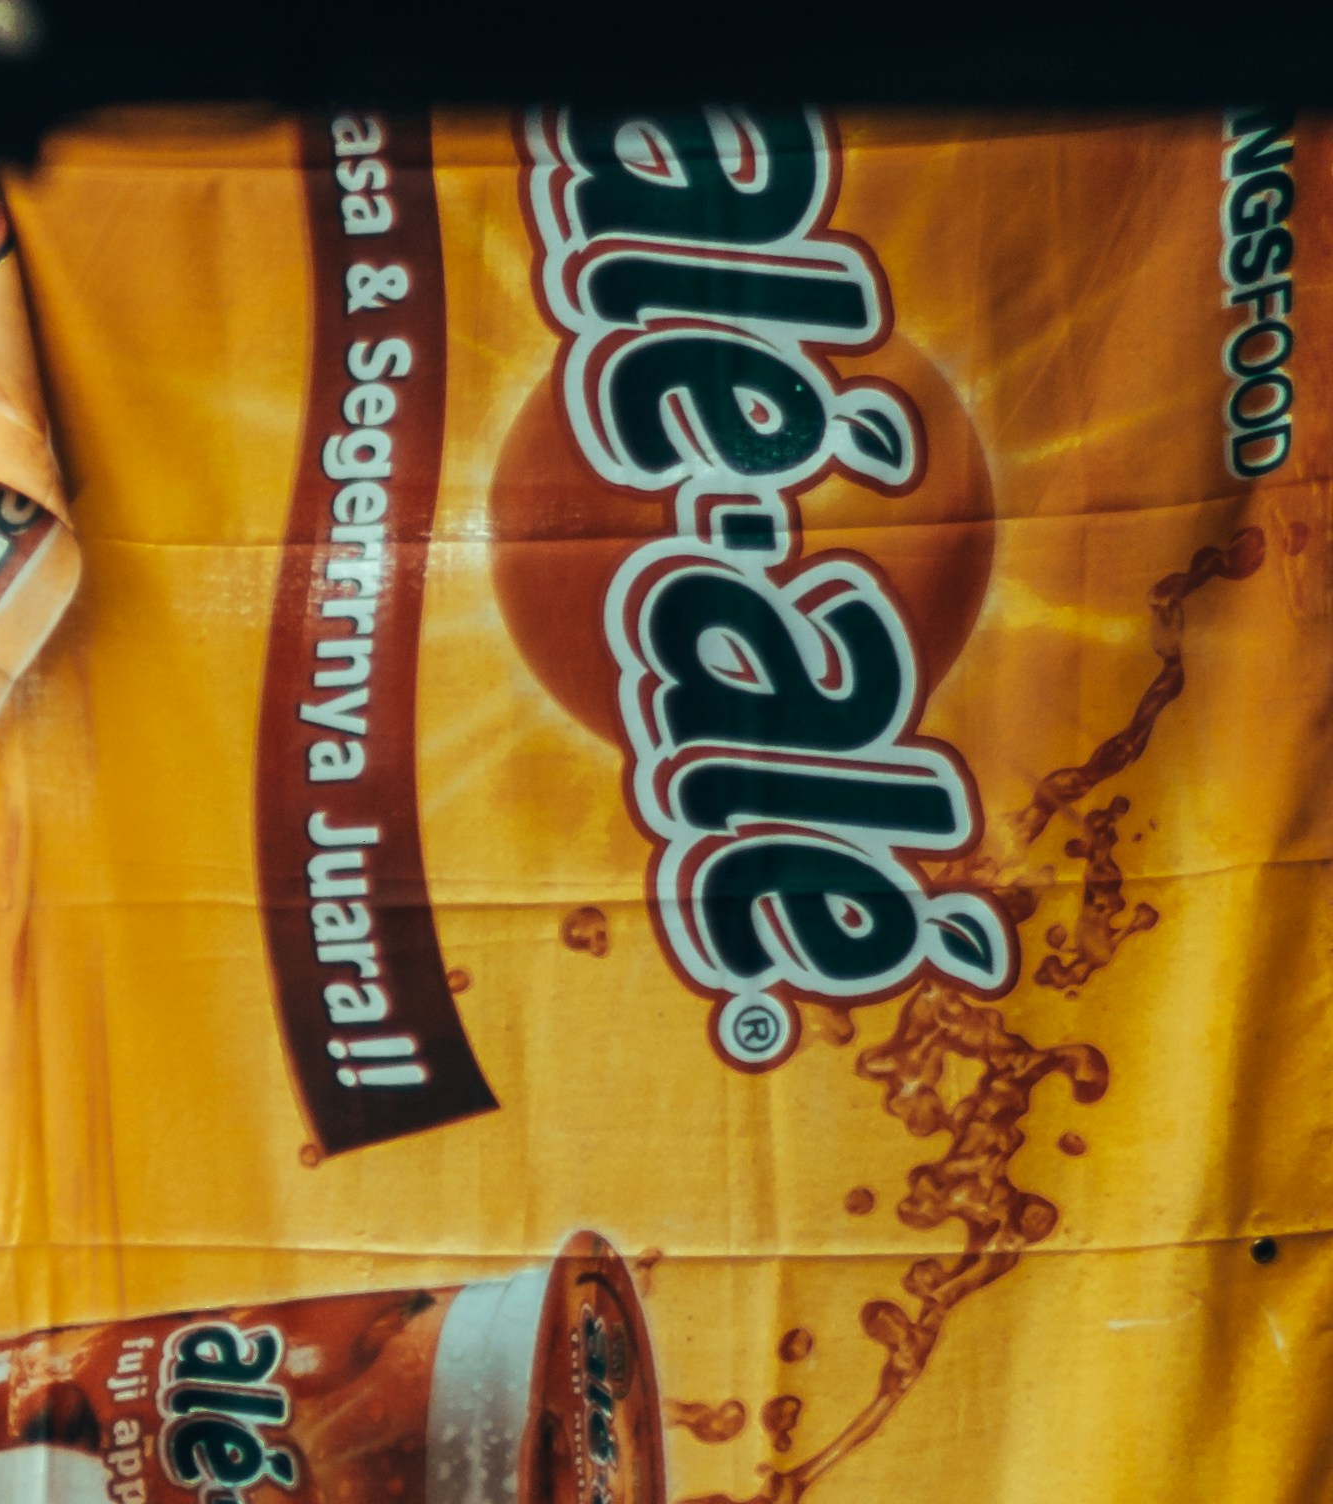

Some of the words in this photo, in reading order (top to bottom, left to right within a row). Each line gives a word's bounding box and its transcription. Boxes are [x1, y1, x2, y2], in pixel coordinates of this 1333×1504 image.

[345, 264, 410, 313] &
[300, 336, 412, 783] Segerrrnya
[308, 809, 427, 1090] Juara!!
[107, 1337, 156, 1401] fuji
